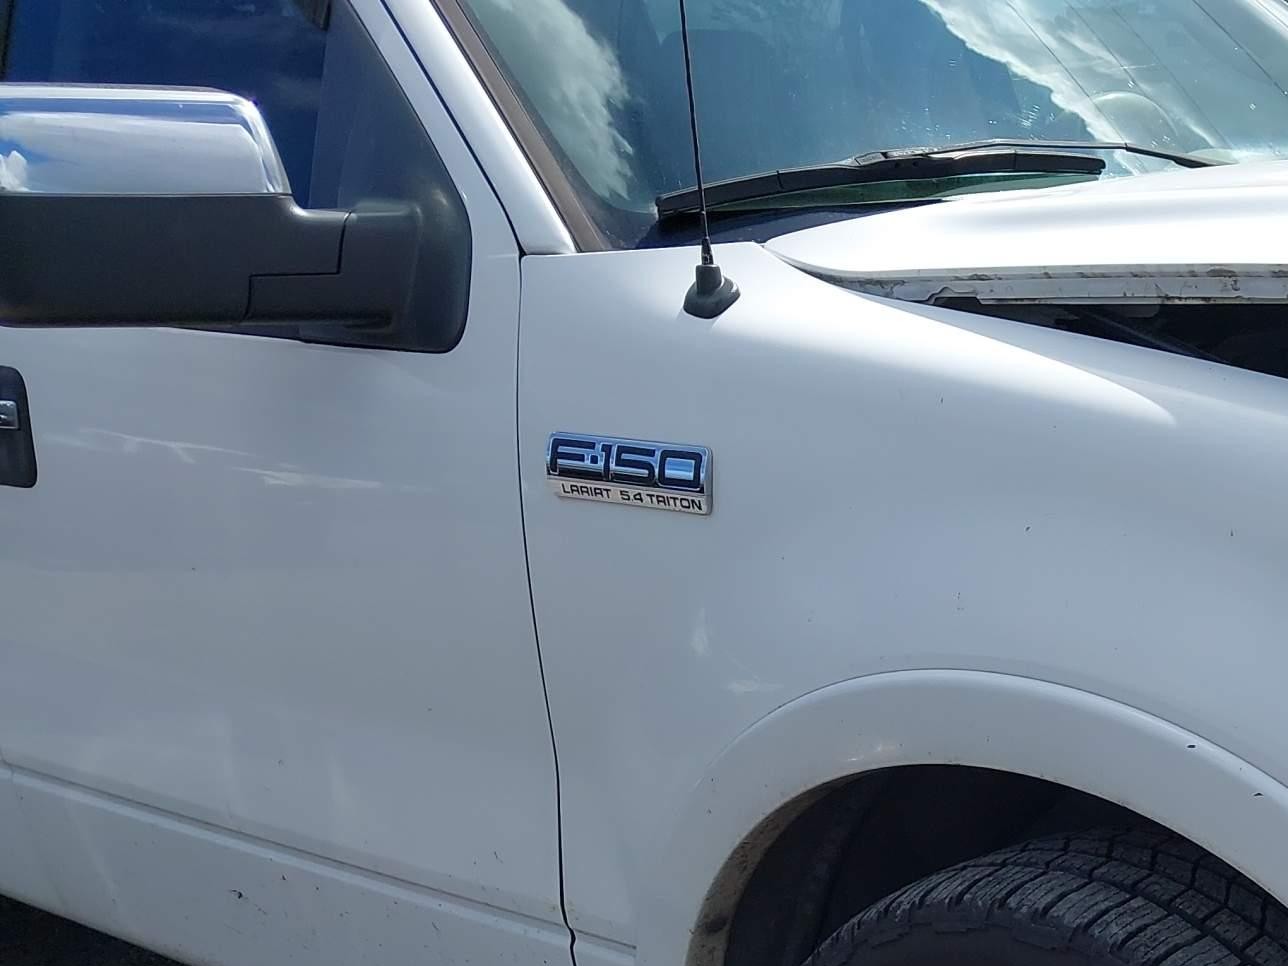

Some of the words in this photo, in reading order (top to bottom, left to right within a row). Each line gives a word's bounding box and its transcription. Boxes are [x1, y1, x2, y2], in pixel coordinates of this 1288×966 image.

[561, 483, 612, 500] LARIAT
[619, 489, 644, 504] 5.4
[645, 493, 703, 512] TRITON
